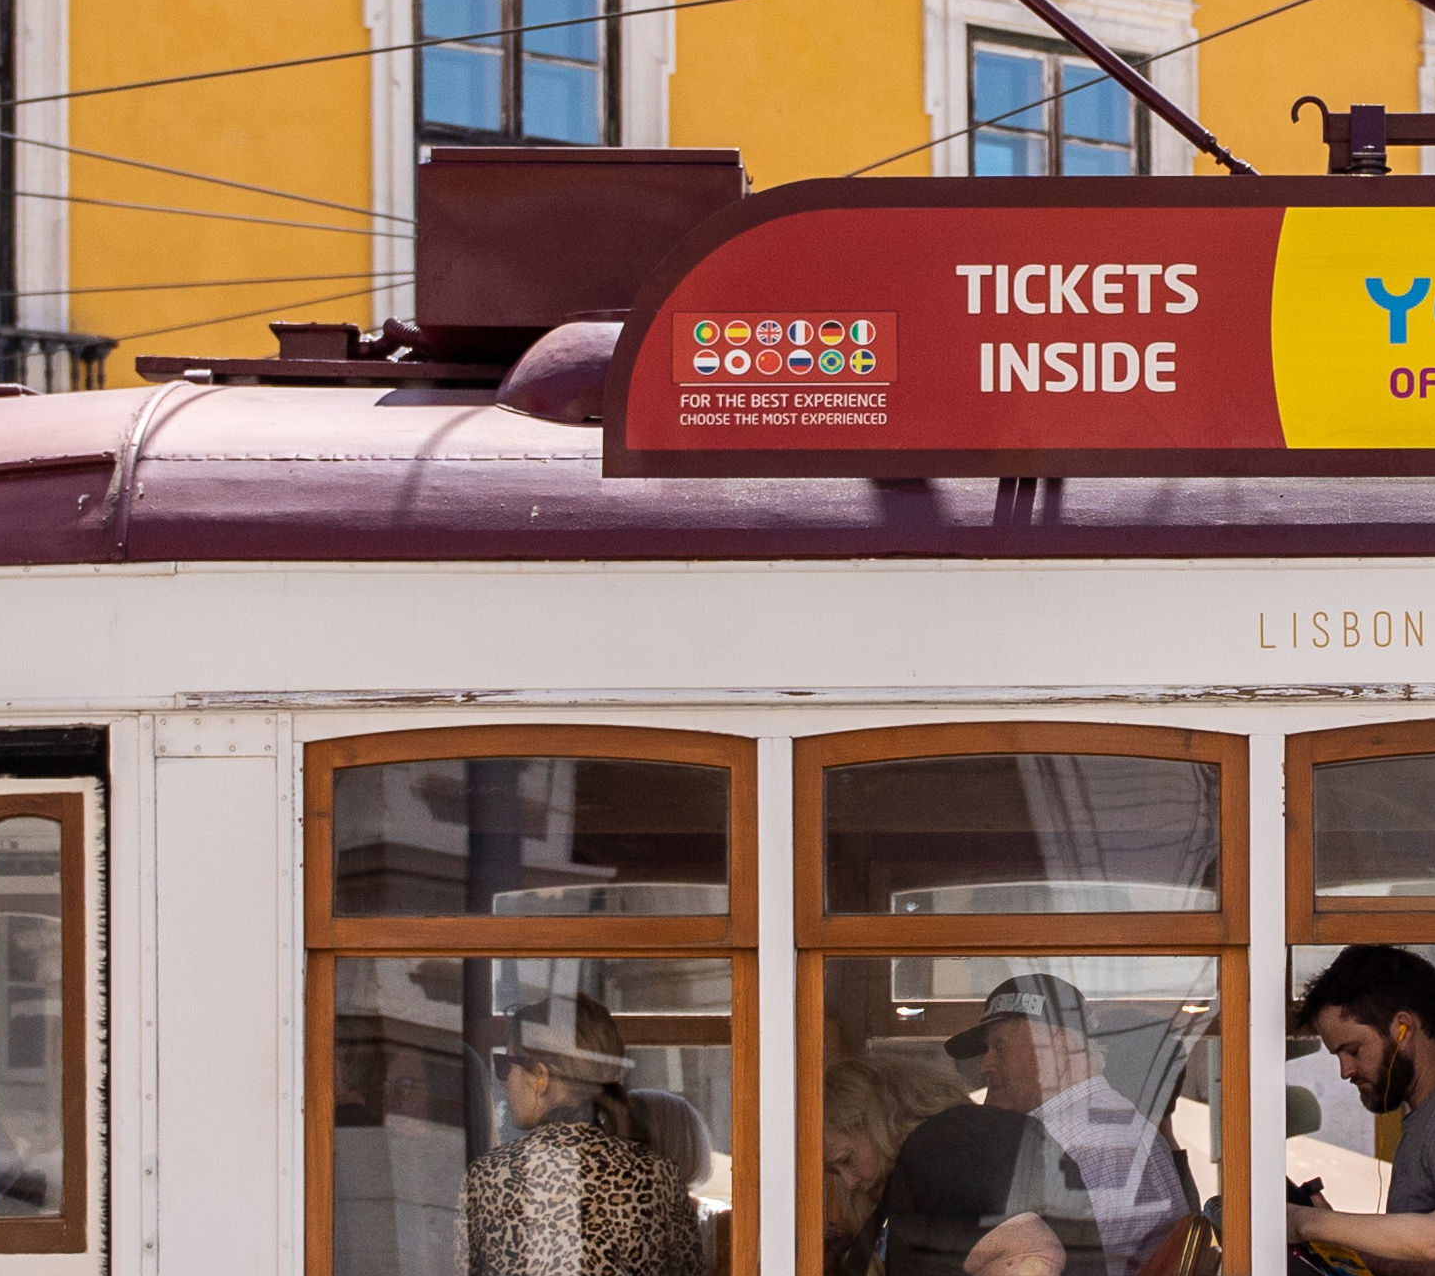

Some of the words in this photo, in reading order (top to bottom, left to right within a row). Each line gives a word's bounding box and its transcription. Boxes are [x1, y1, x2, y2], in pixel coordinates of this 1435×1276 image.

[955, 263, 1199, 314] TICKETS
[980, 341, 1176, 393] INSIDE
[679, 413, 731, 425] CHOOSE
[734, 413, 759, 425] THE
[762, 412, 798, 425] MOST
[801, 412, 888, 425] EXPERIENCED
[680, 393, 711, 408] FOR
[716, 393, 746, 408] THE
[750, 393, 789, 408] BEST
[794, 393, 887, 408] EXPERIENCE
[1259, 611, 1424, 649] LISBON
